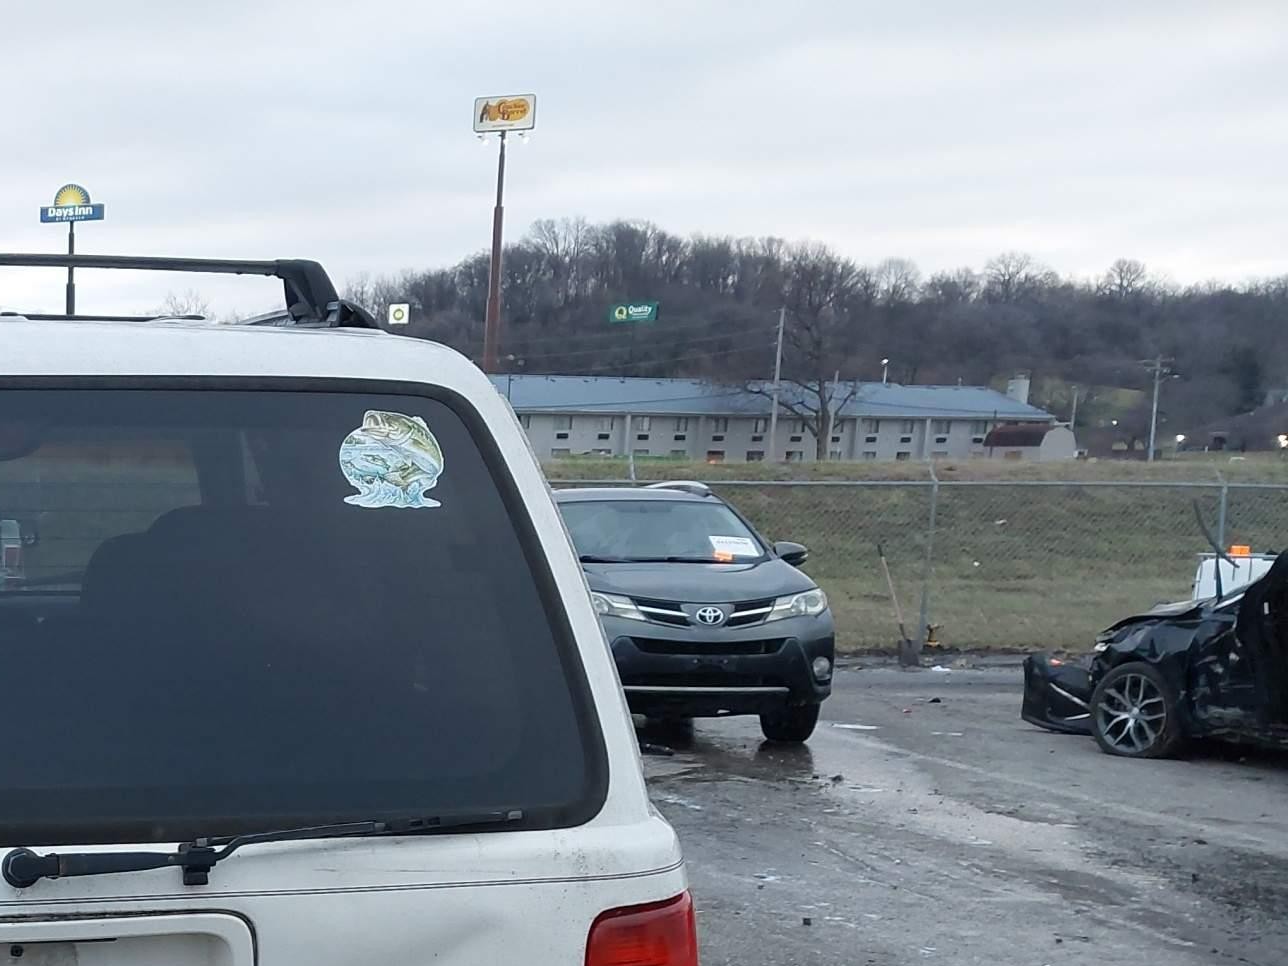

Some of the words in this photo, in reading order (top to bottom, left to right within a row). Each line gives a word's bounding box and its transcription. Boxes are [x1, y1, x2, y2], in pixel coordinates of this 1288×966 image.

[48, 207, 74, 217] Days
[75, 206, 93, 216] Inn
[628, 304, 653, 315] Quality
